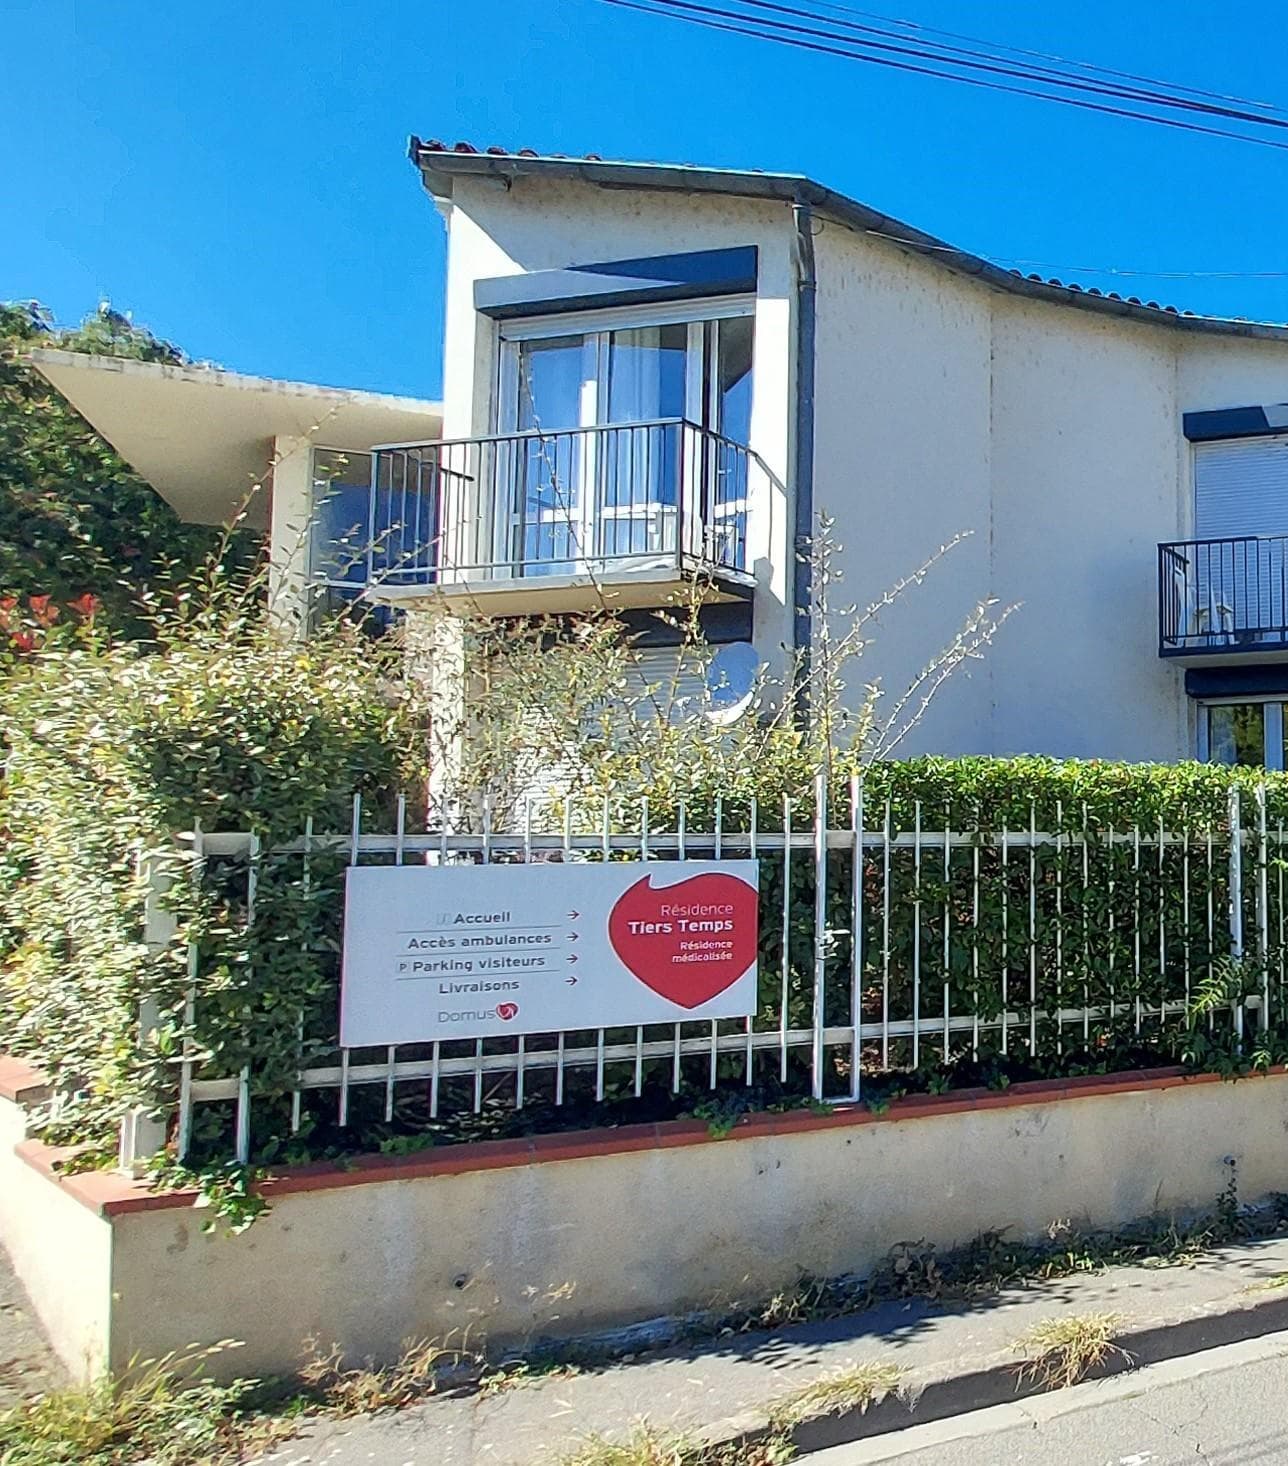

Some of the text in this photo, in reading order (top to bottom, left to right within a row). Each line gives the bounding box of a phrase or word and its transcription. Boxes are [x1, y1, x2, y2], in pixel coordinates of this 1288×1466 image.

[661, 903, 733, 916] Résidence
[453, 911, 511, 925] Accueil
[628, 919, 733, 934] Tiers Temps
[408, 934, 552, 949] Accès ambulances
[680, 940, 733, 950] Résidence
[672, 950, 733, 963] médicalisée
[412, 959, 473, 972] Parking
[478, 956, 545, 969] visiteurs
[439, 980, 520, 994] Livraisons
